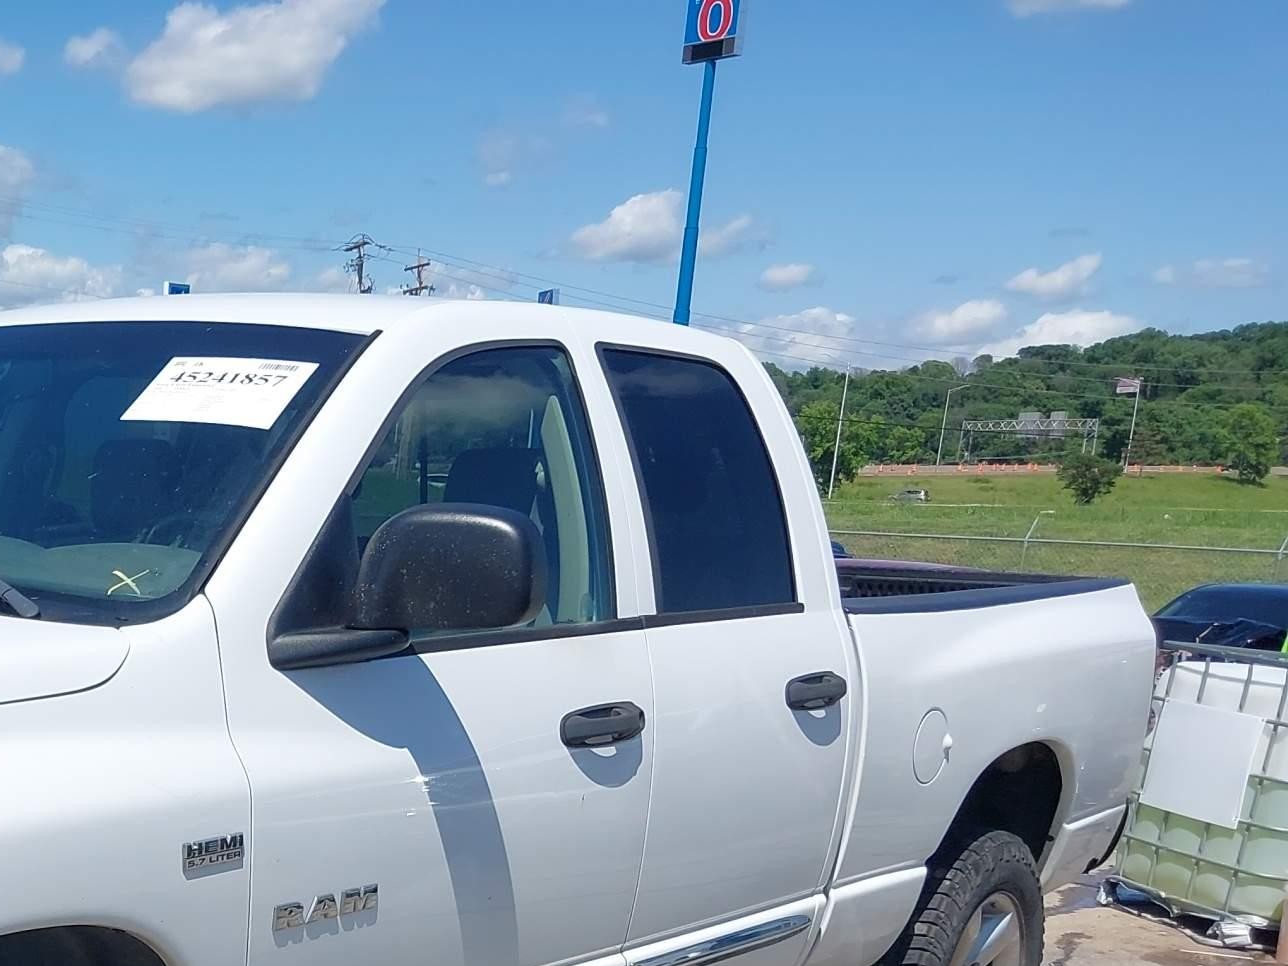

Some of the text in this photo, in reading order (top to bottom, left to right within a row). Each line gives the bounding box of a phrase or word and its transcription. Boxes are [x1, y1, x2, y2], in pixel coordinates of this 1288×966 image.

[170, 370, 289, 388] 45241857
[186, 833, 244, 859] HEMI
[187, 850, 242, 869] 5.7 LITER
[271, 883, 379, 933] RAM
